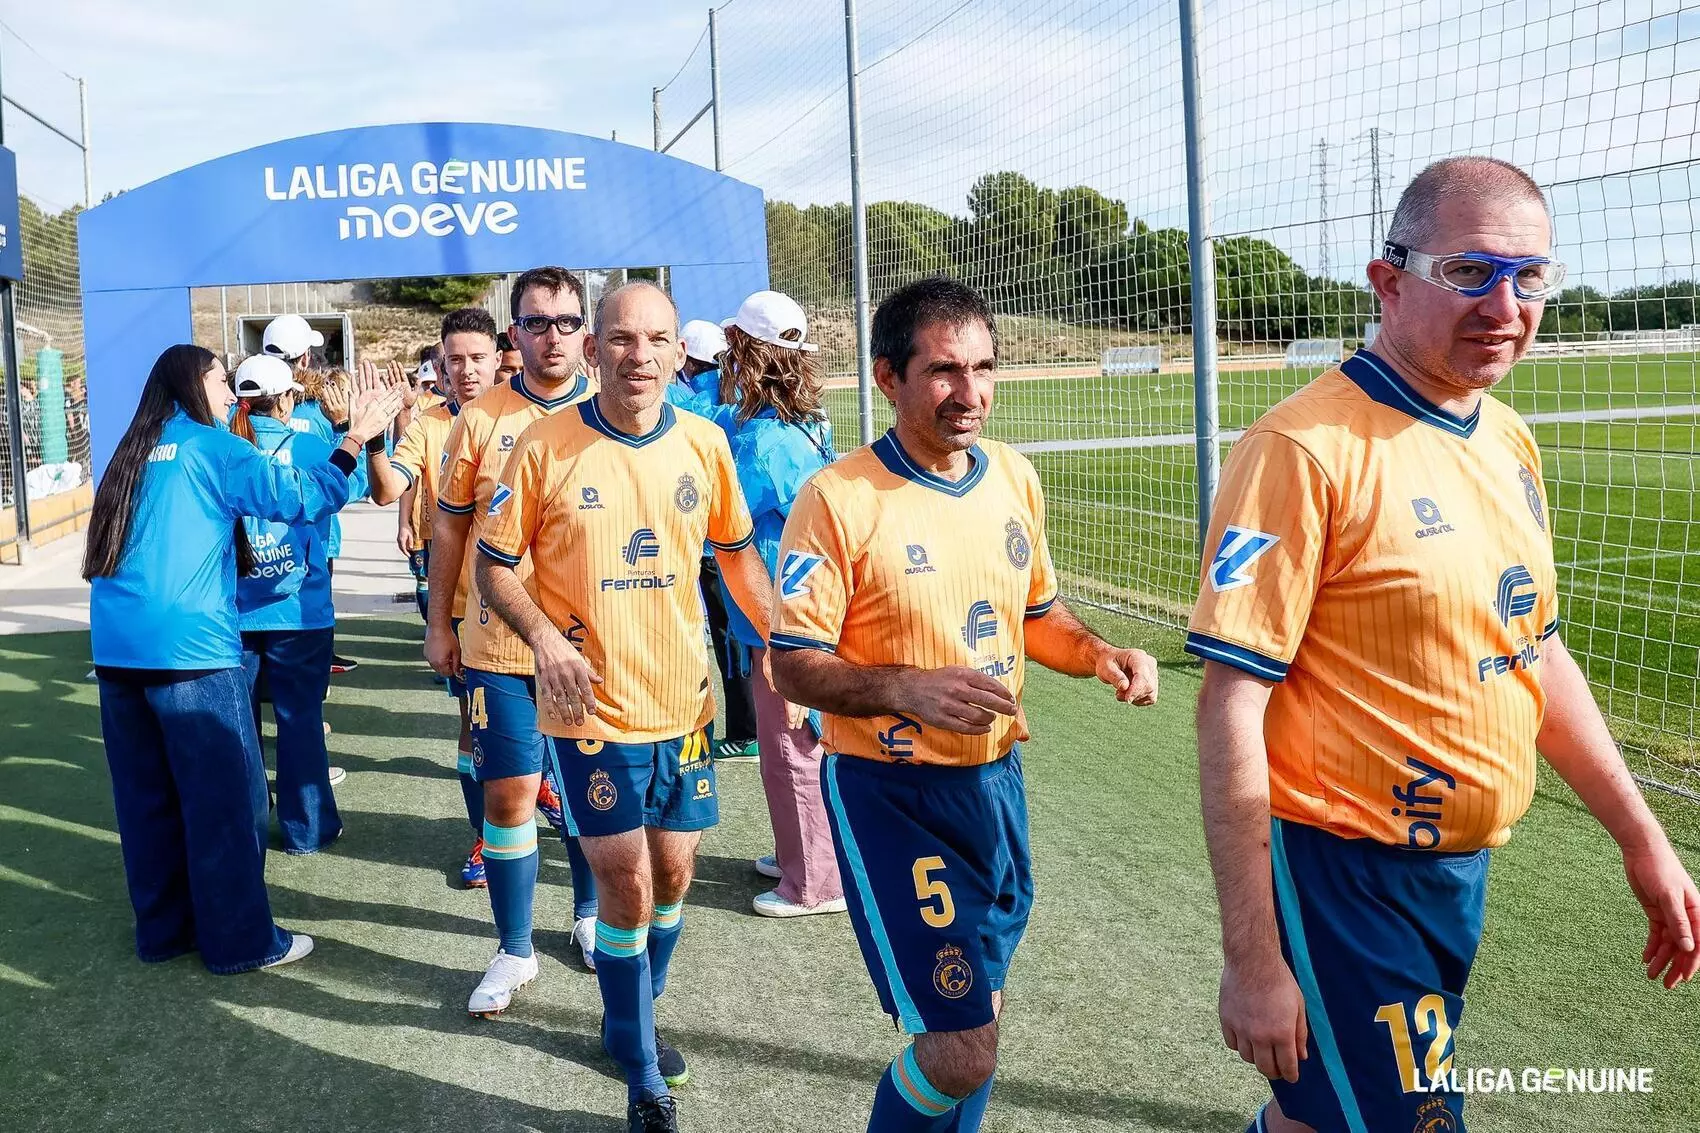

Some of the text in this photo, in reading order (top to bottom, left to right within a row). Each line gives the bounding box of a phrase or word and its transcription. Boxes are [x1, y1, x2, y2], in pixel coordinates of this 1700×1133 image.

[264, 157, 587, 200] LALIGA GENUINE
[339, 200, 518, 240] moeve
[467, 687, 489, 730] 4
[912, 855, 956, 928] 5
[1374, 994, 1454, 1093] 12
